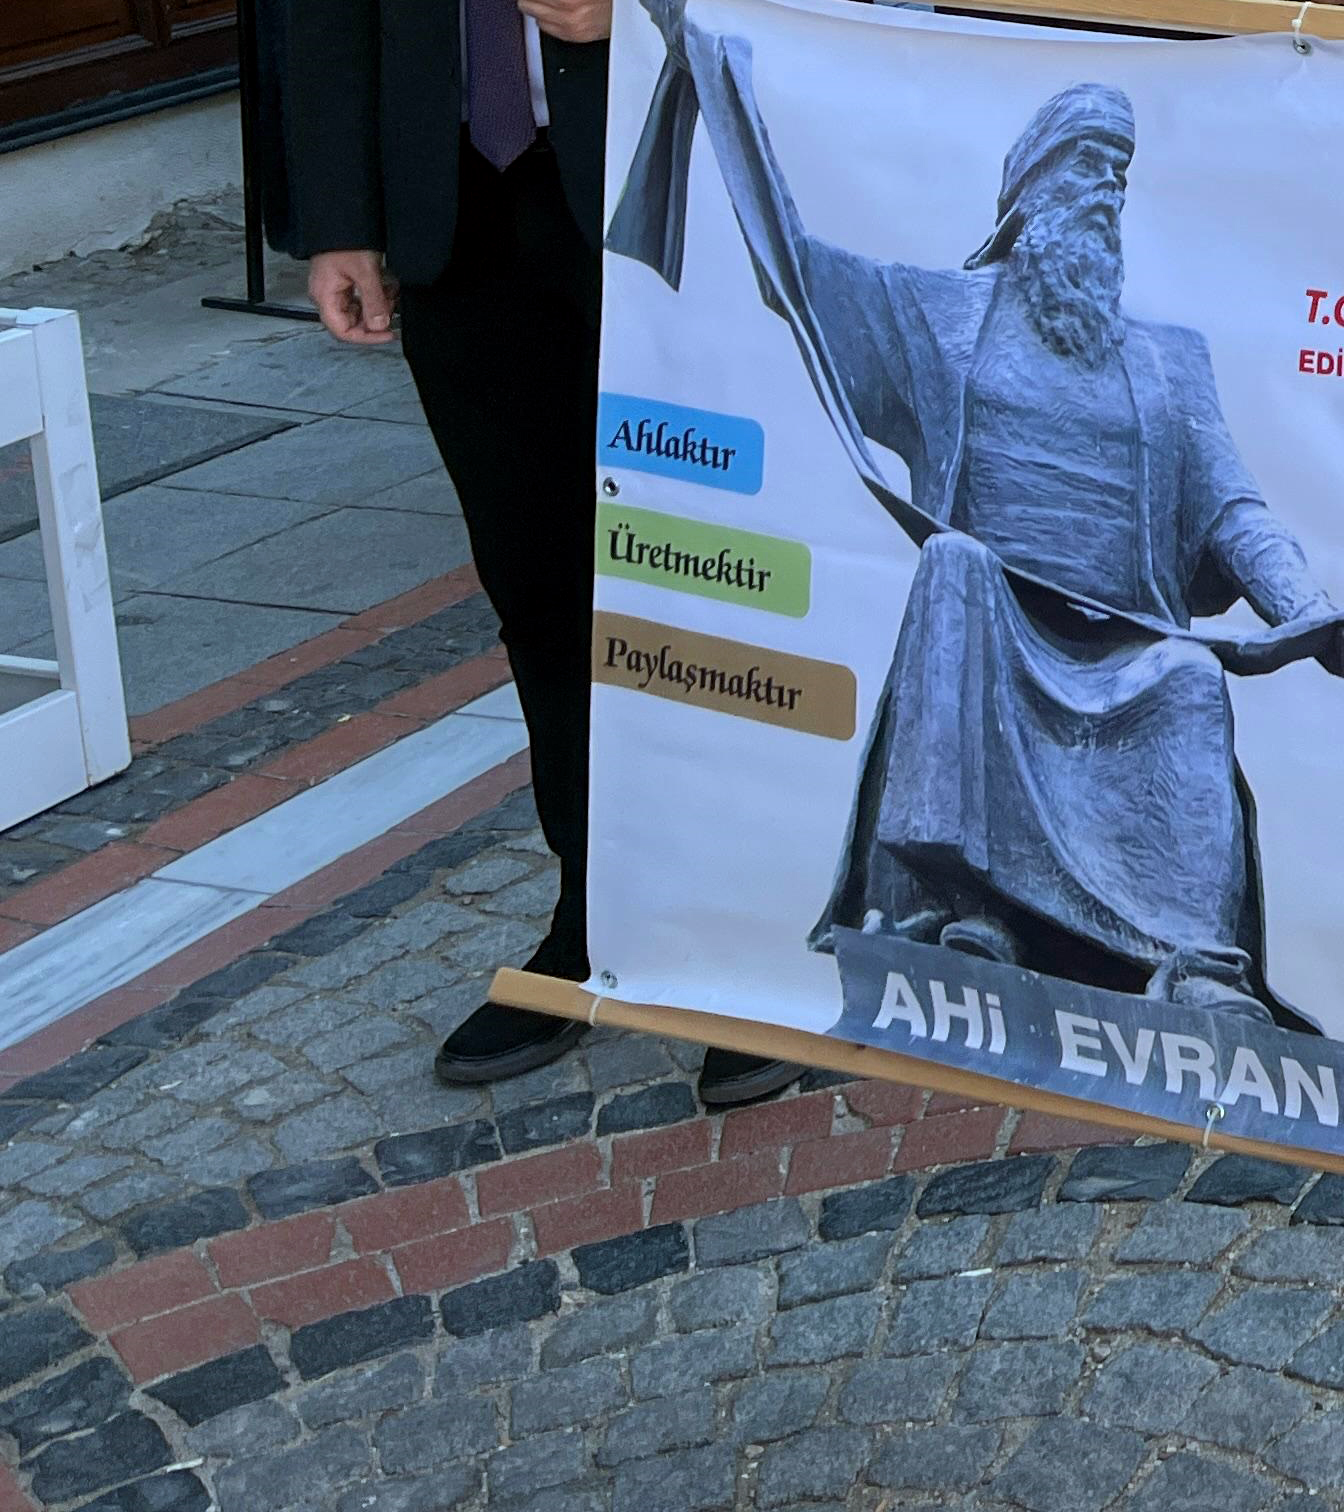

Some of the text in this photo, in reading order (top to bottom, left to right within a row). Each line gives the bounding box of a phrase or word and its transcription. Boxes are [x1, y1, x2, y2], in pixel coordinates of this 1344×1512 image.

[606, 418, 737, 472] Ahlaktır
[607, 522, 772, 593] Üretmektir
[603, 636, 803, 711] Paylaşmaktır
[1054, 1009, 1340, 1128] EVRAN
